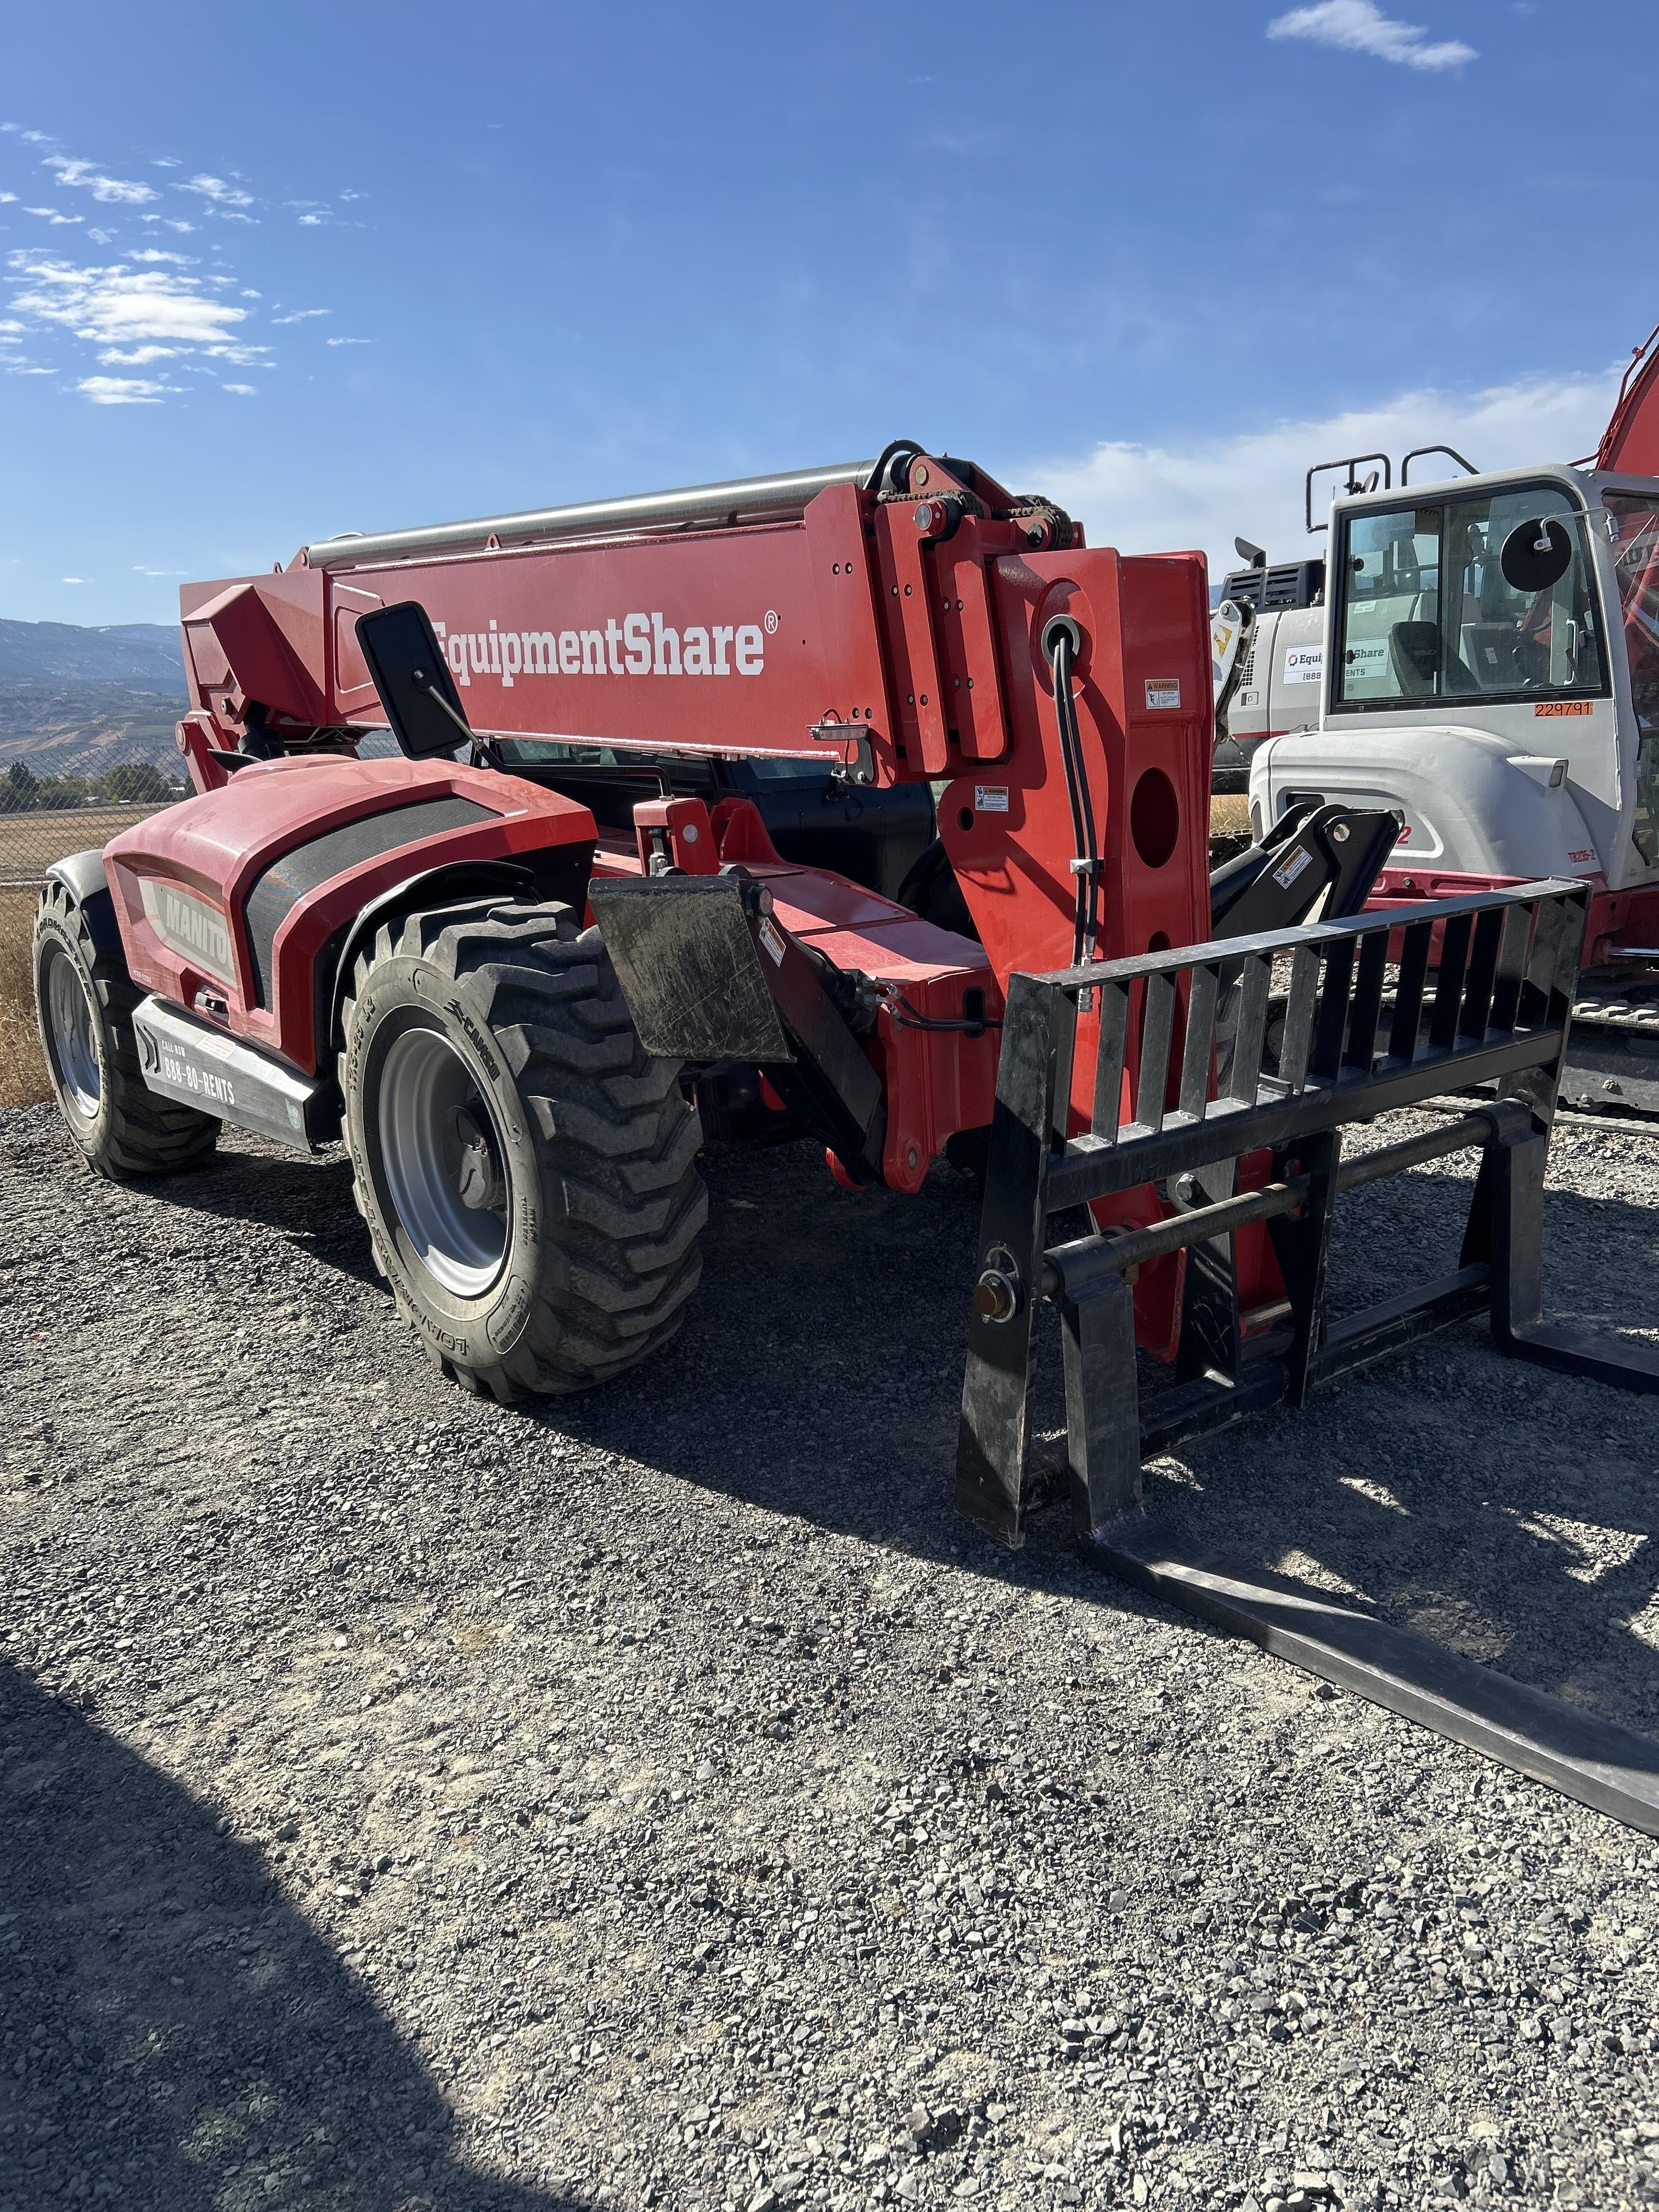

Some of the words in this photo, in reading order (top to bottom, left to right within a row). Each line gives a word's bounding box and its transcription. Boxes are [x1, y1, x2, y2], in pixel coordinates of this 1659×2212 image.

[1299, 653, 1323, 665] Equi
[1536, 702, 1590, 716] 229791
[464, 1016, 501, 1082] CAMSO
[165, 1057, 235, 1105] 888-80-RENTS
